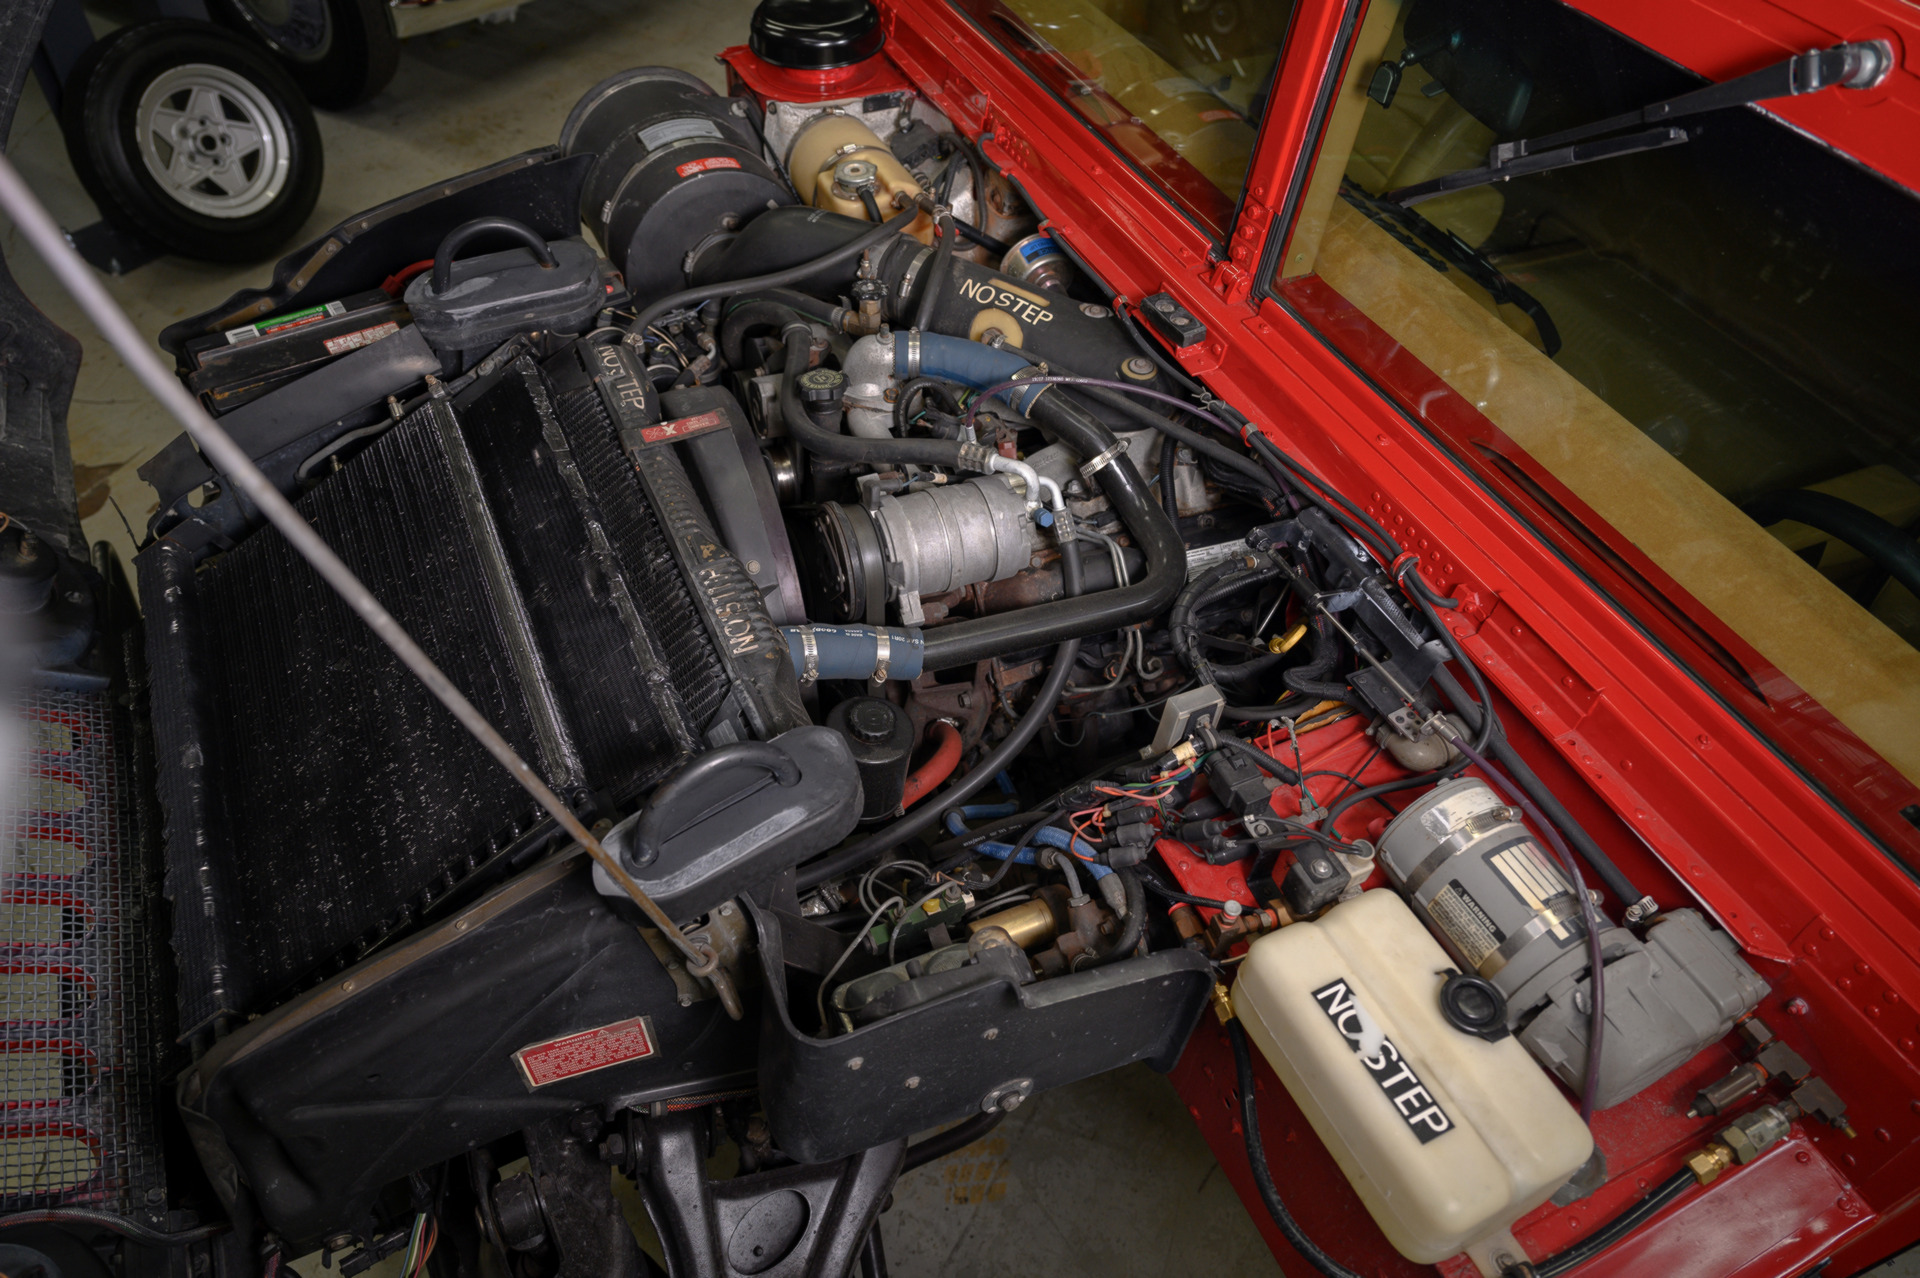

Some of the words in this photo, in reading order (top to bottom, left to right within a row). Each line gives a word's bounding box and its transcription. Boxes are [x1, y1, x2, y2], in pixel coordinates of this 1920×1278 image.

[959, 278, 996, 304] NO
[994, 292, 1054, 326] STEP
[724, 618, 760, 655] NO
[789, 626, 838, 634] GOODYAR
[1462, 894, 1497, 933] WARNING
[554, 1033, 594, 1048] WARNING!
[1364, 1040, 1449, 1133] STEP
